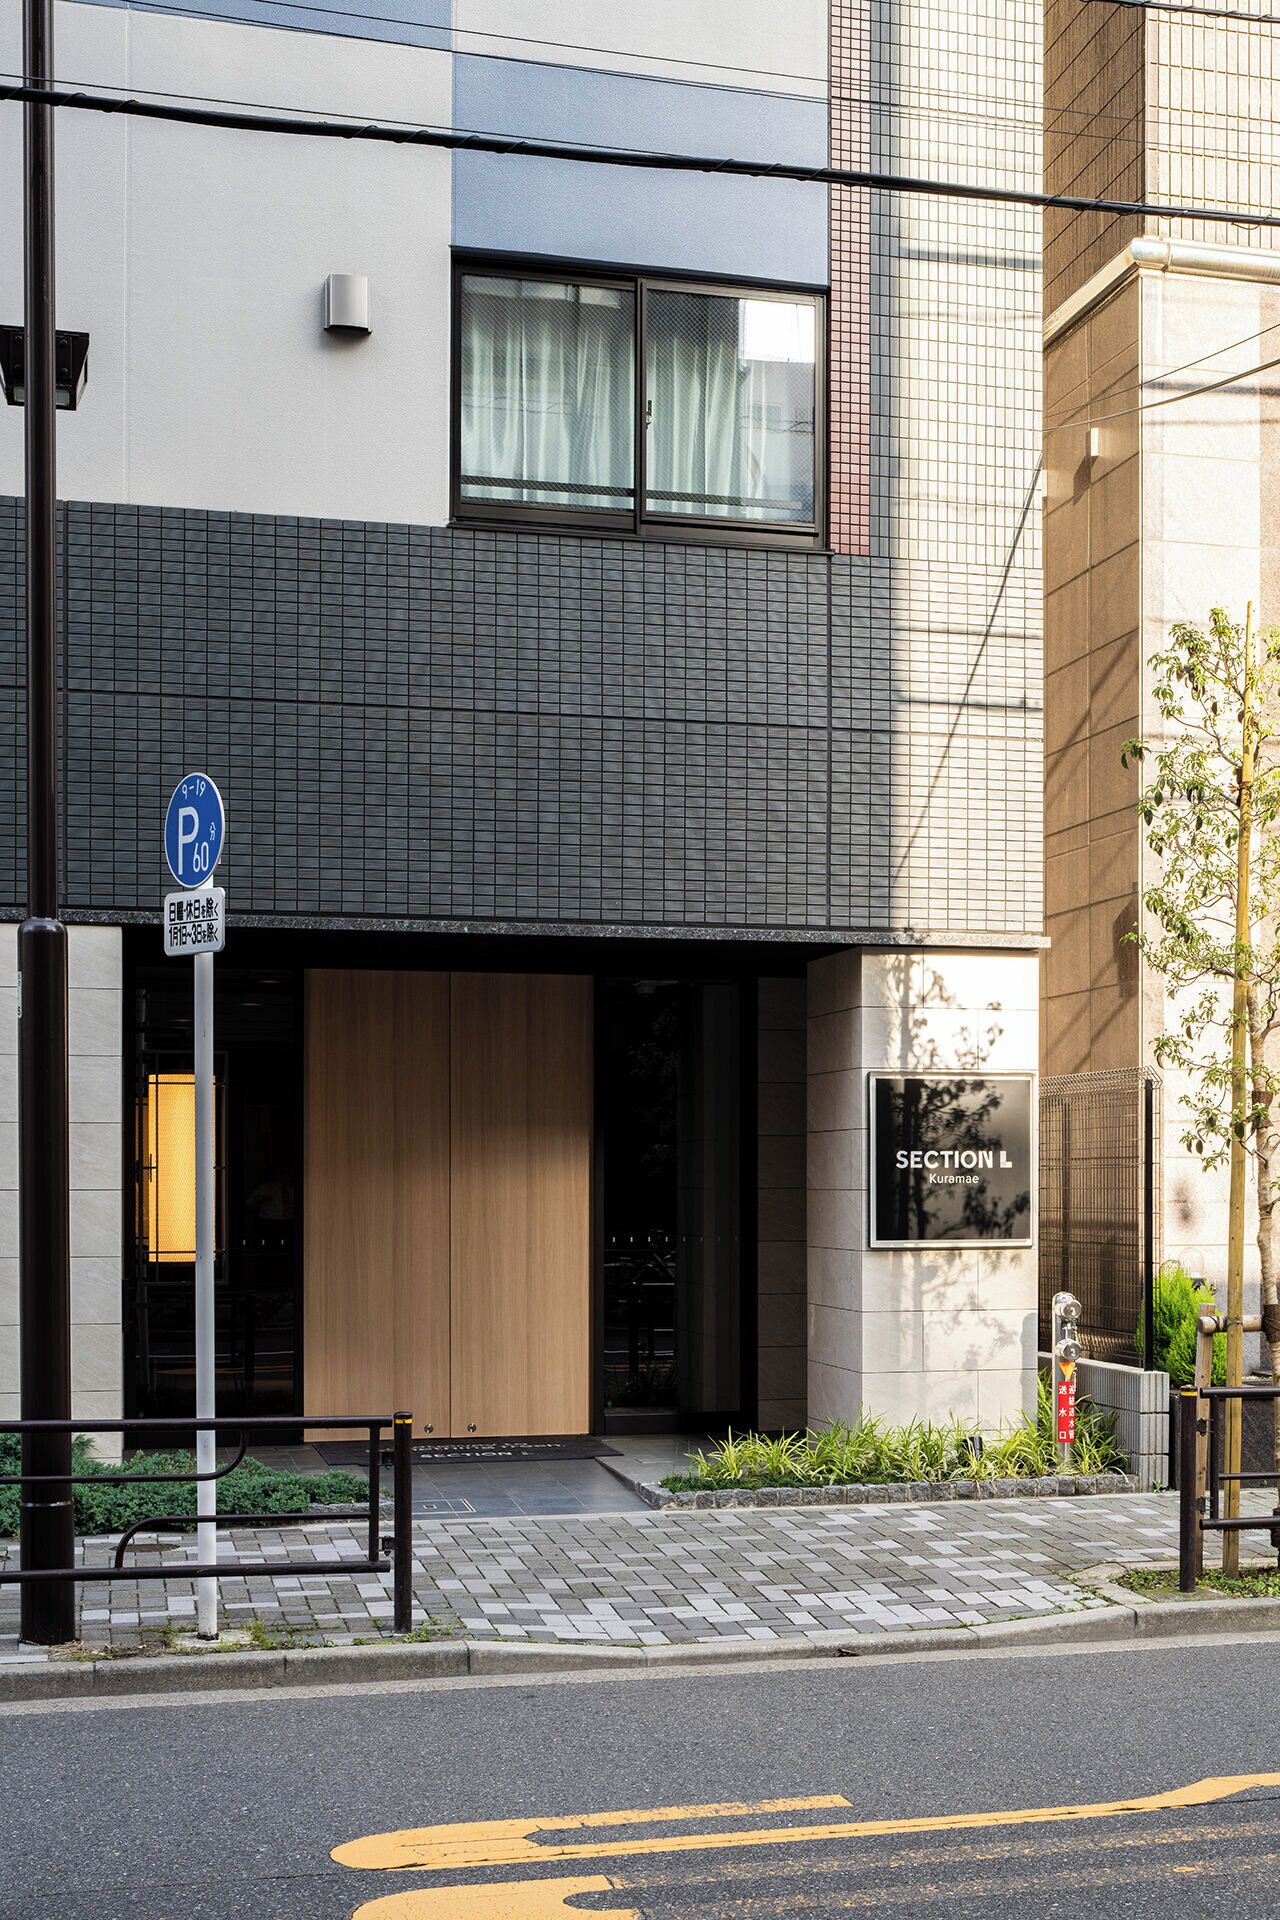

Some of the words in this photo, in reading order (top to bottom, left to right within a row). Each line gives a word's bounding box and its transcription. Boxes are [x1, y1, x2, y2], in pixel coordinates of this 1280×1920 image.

[182, 779, 206, 799] 9-19
[178, 806, 199, 875] P
[895, 1150, 993, 1169] SECTION
[1000, 1150, 1013, 1169] L
[929, 1173, 980, 1184] Kuramae
[1059, 1385, 1068, 1439] 送水口
